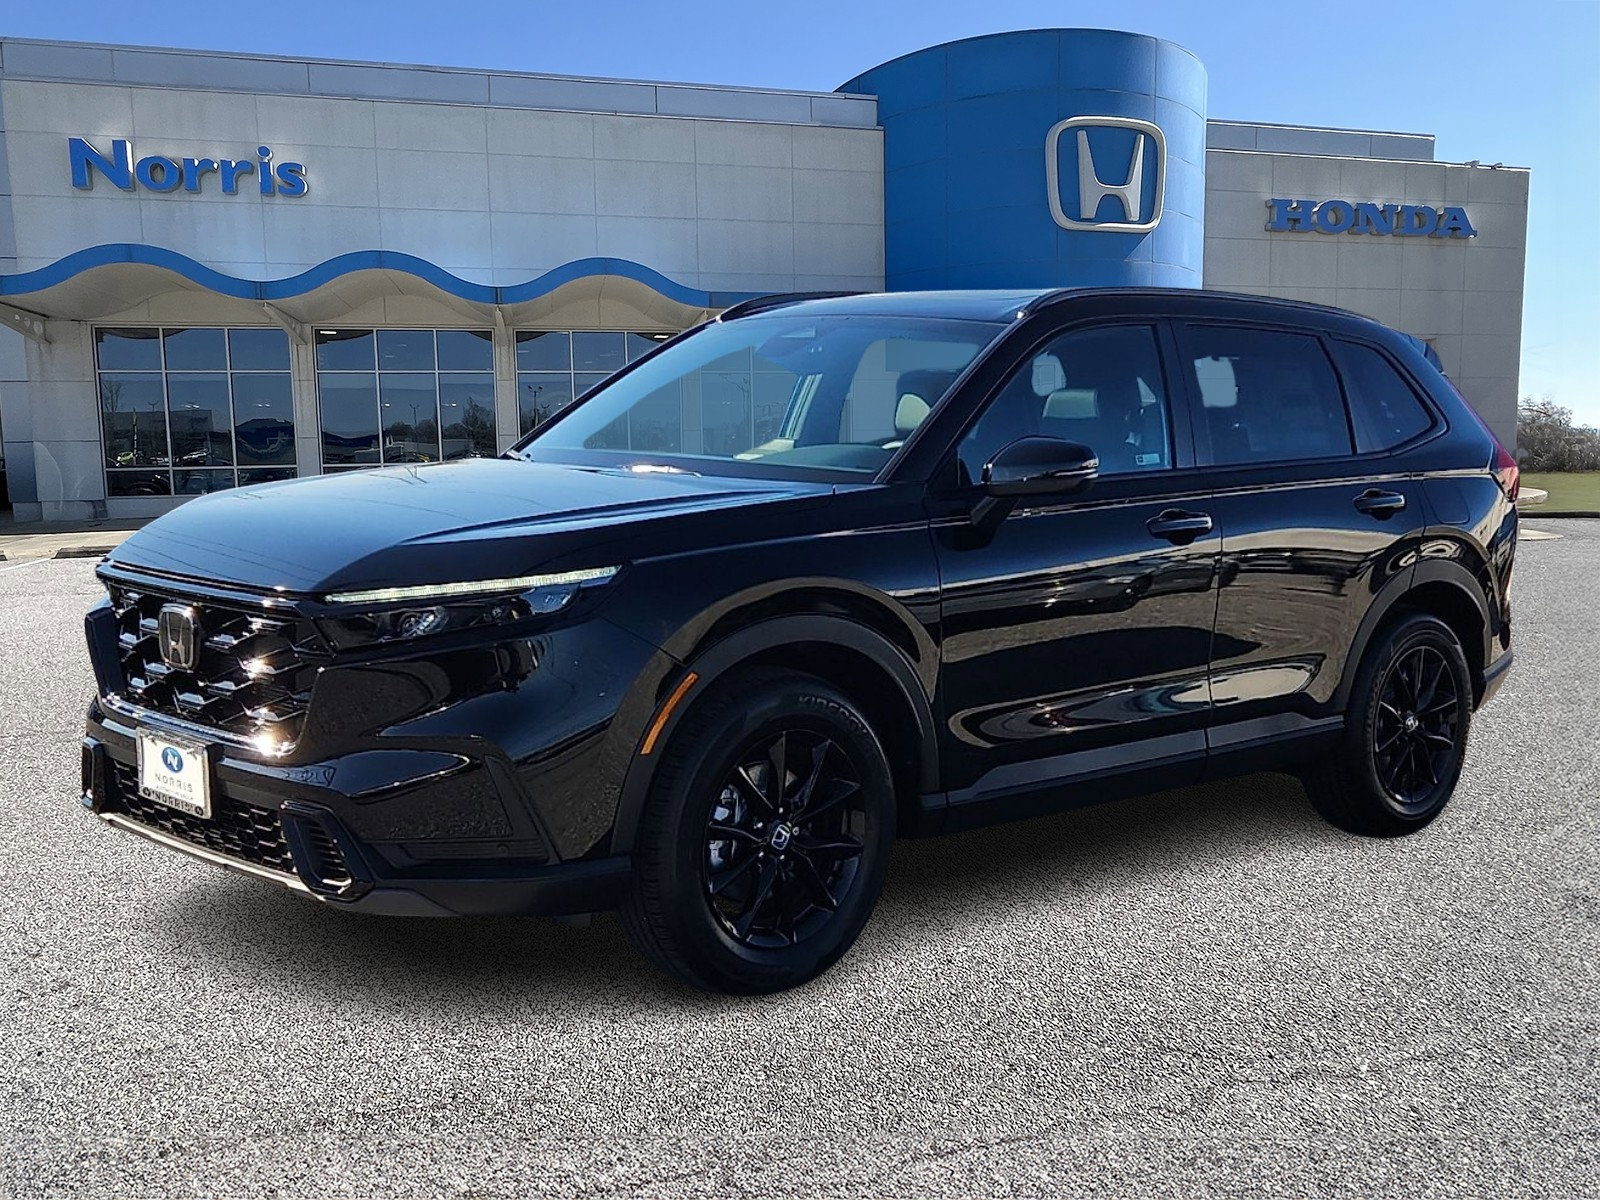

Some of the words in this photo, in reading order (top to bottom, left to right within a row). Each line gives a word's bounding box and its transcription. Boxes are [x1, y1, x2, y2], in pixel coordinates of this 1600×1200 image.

[68, 137, 309, 197] Norris
[1265, 198, 1478, 240] HONDA
[154, 772, 194, 792] NORRIS
[154, 792, 192, 811] NORRIS
